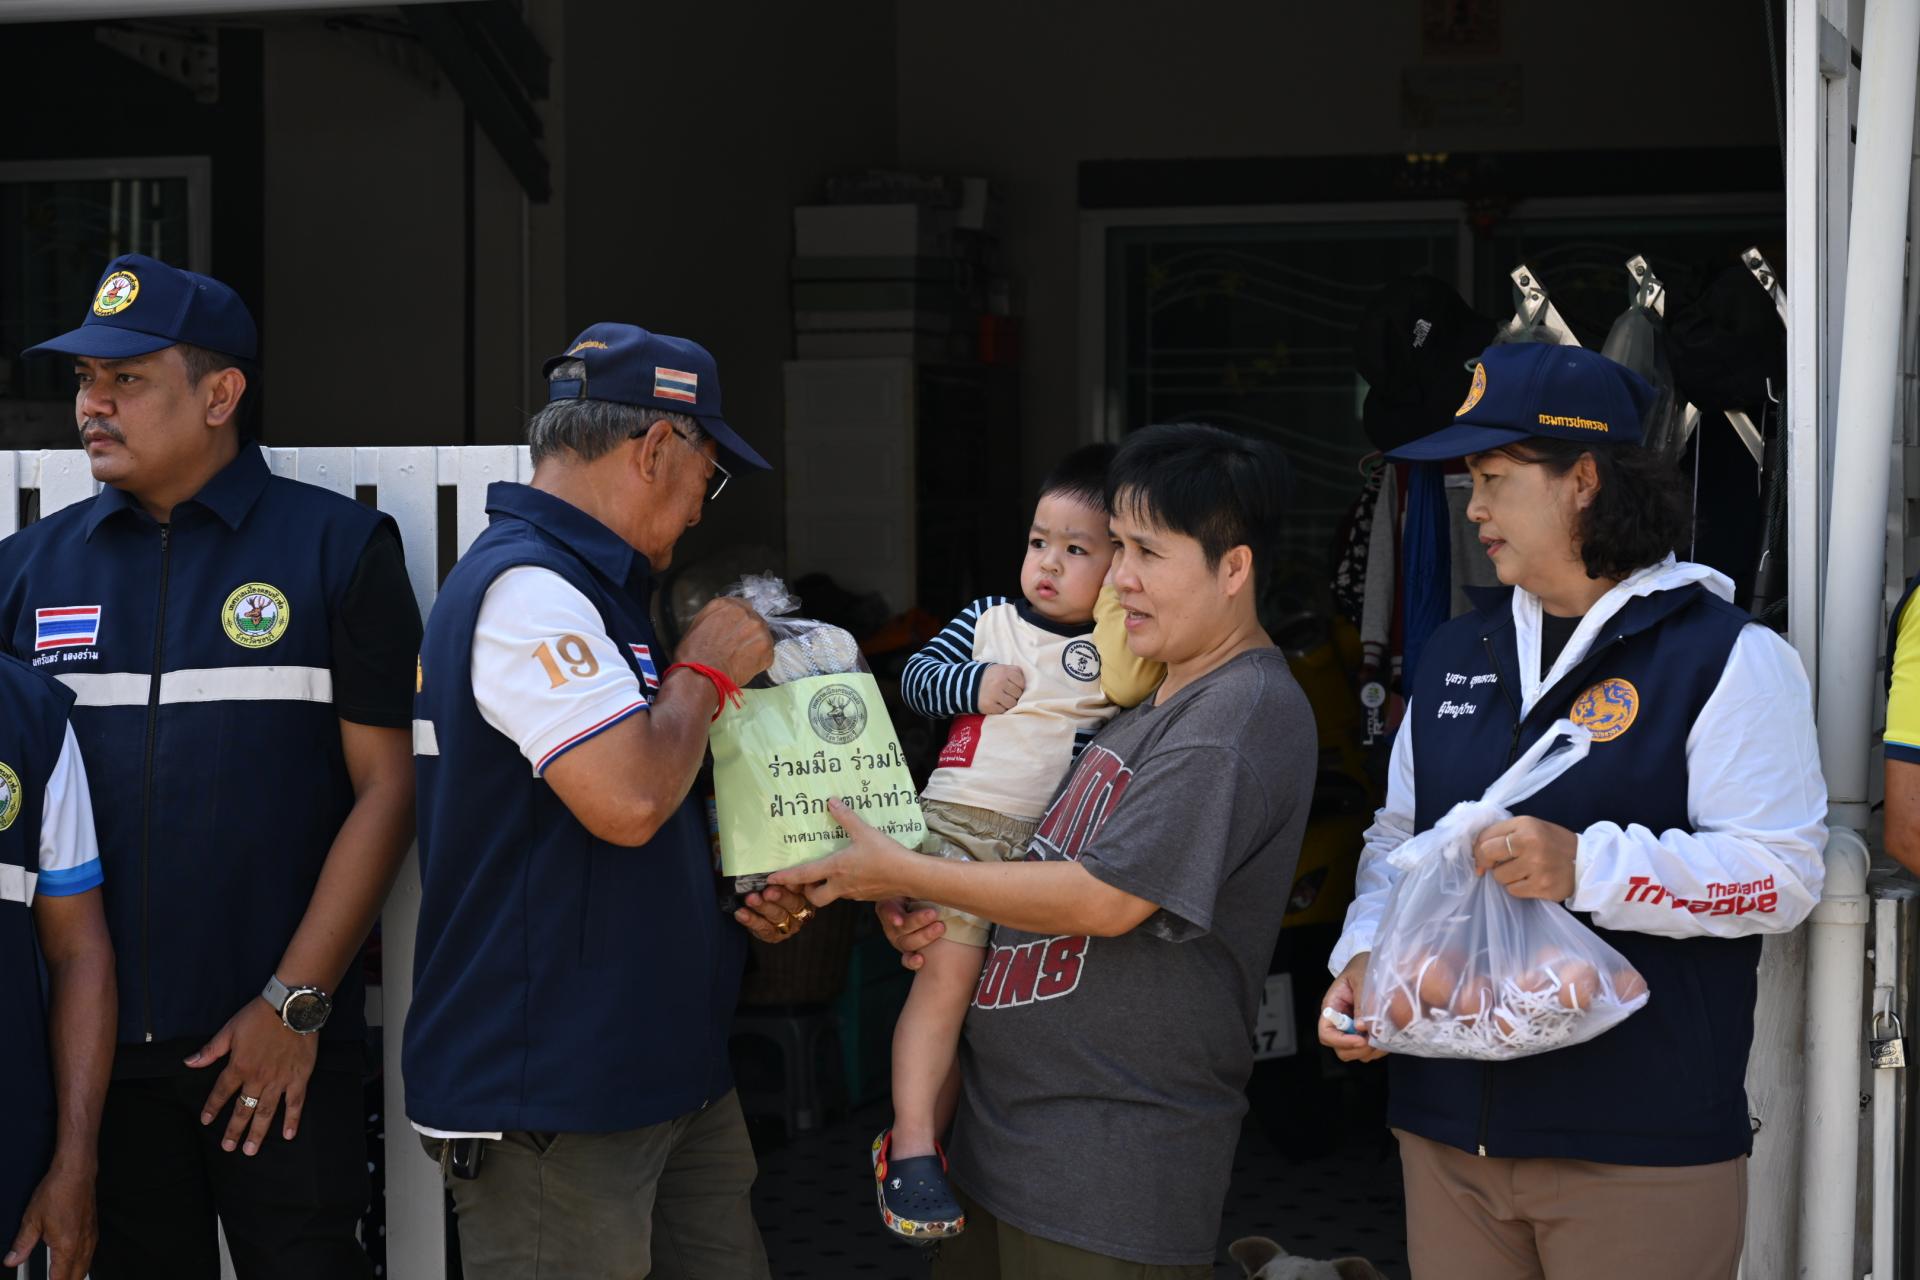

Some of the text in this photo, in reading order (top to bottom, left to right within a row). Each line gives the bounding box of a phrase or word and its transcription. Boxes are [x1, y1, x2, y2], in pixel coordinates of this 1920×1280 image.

[531, 633, 600, 689] 19
[768, 750, 842, 778] ร่วมมือ
[770, 780, 920, 818] ฝ่าวิกตน้ำท่ว
